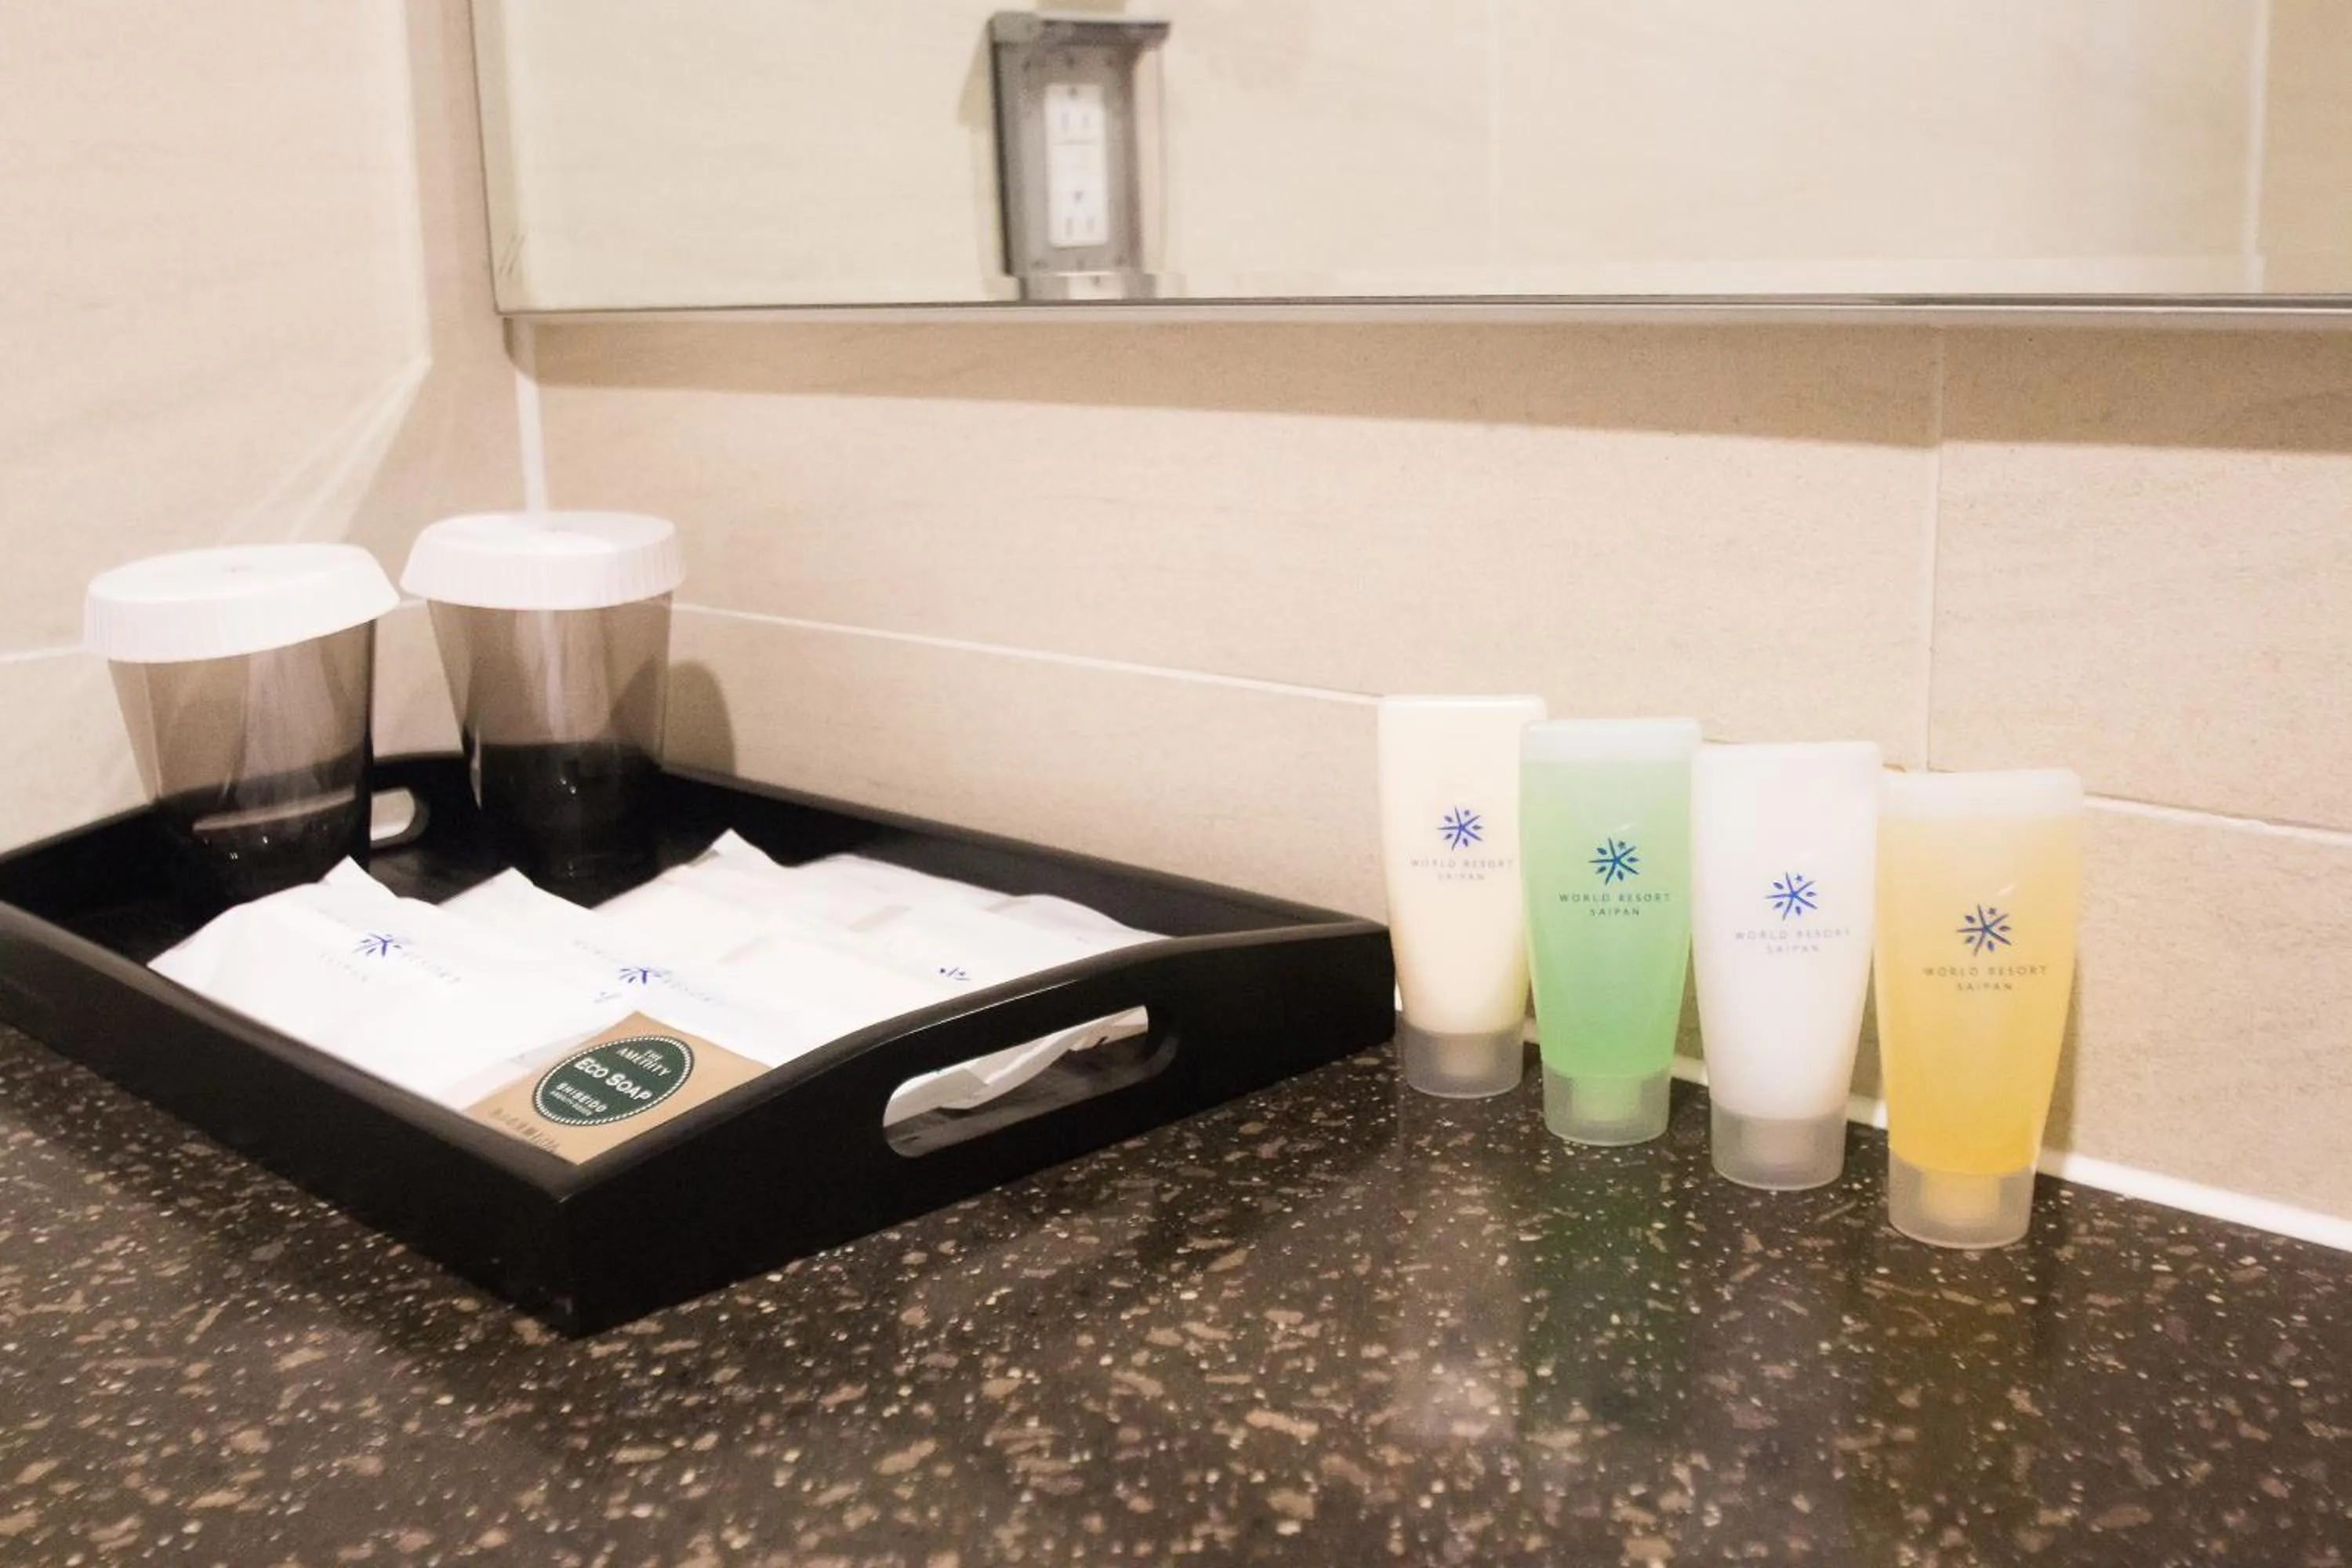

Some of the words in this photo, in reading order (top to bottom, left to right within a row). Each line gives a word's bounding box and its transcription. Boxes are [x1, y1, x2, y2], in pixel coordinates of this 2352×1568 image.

[1410, 858, 1456, 869] WORLD
[1463, 858, 1514, 869] RESORT
[1559, 892, 1610, 903] WORLD
[1619, 892, 1671, 903] RESORT
[1589, 906, 1640, 917] SAIPAN
[1734, 930, 1788, 942] WORLD
[1796, 928, 1851, 940] RESORT
[1766, 944, 1820, 954] SAIPAN
[1922, 966, 1980, 978] WORLD
[1988, 964, 2049, 977] RESORT
[1955, 982, 2013, 993] SAIPAN
[615, 1047, 671, 1076] AMENITY
[574, 1056, 609, 1079] ECO
[604, 1072, 654, 1102] SOAP
